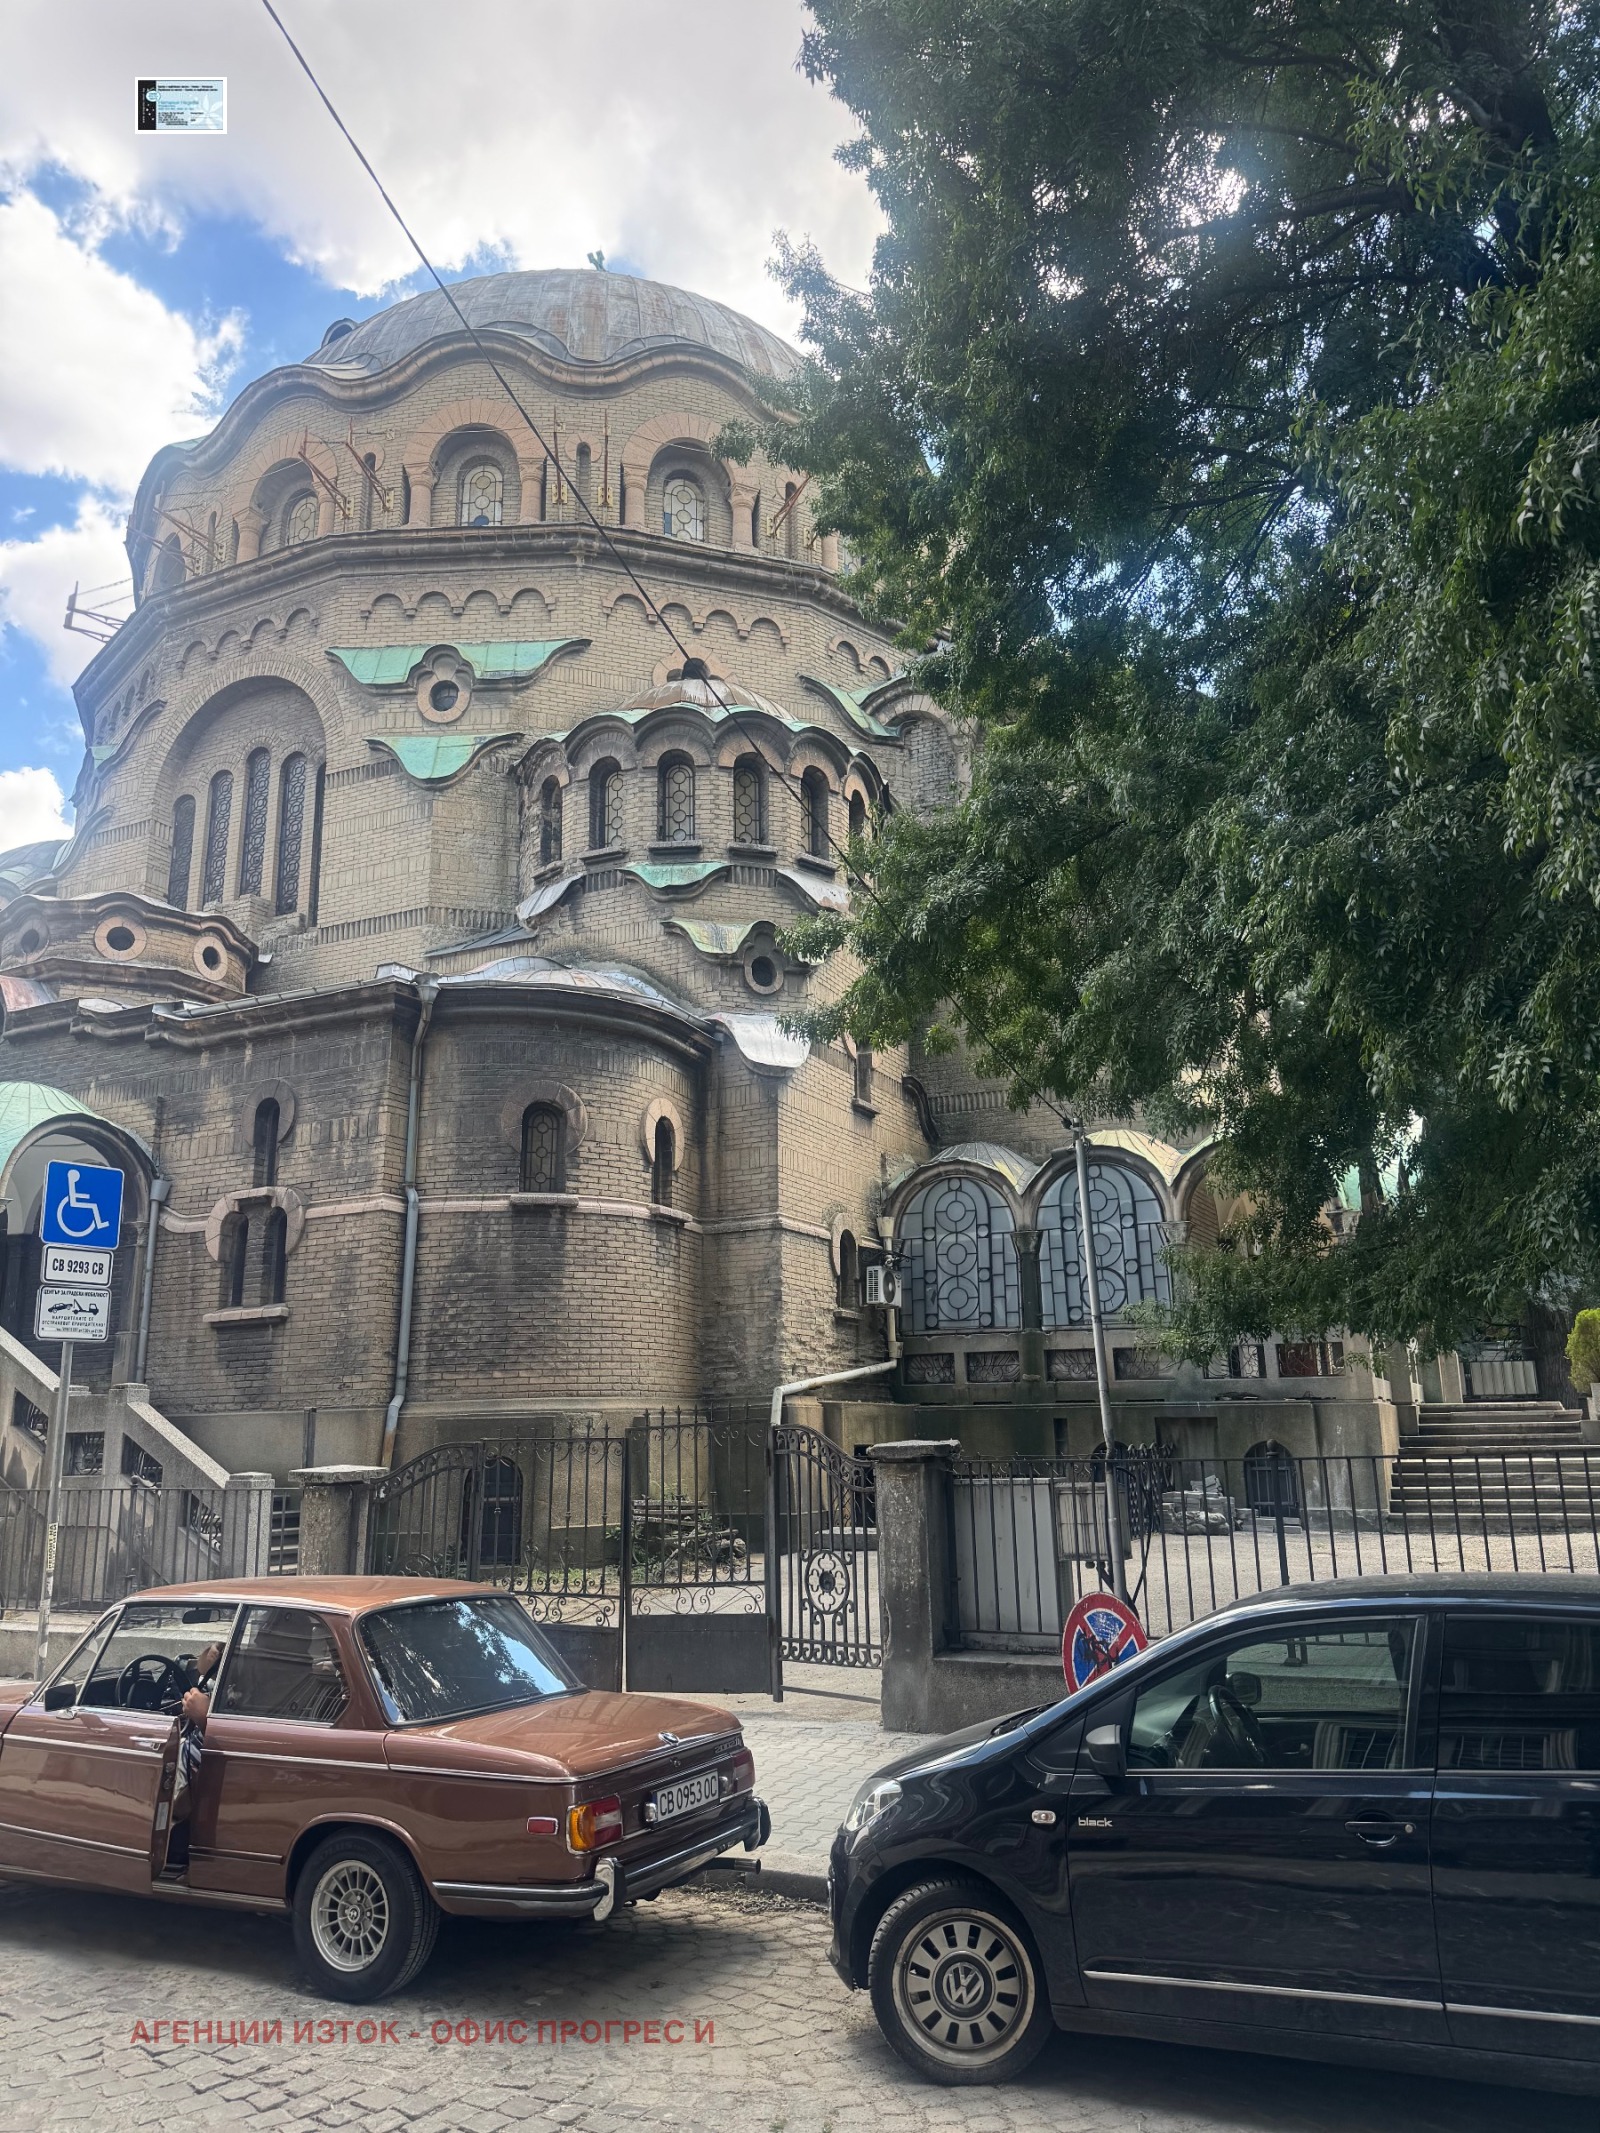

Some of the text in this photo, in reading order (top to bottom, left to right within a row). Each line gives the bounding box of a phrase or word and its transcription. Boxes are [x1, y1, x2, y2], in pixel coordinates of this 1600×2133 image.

[67, 1260, 90, 1274] 9293
[659, 1790, 675, 1817] CB
[676, 1781, 702, 1811] 0953
[1077, 1816, 1113, 1828] black
